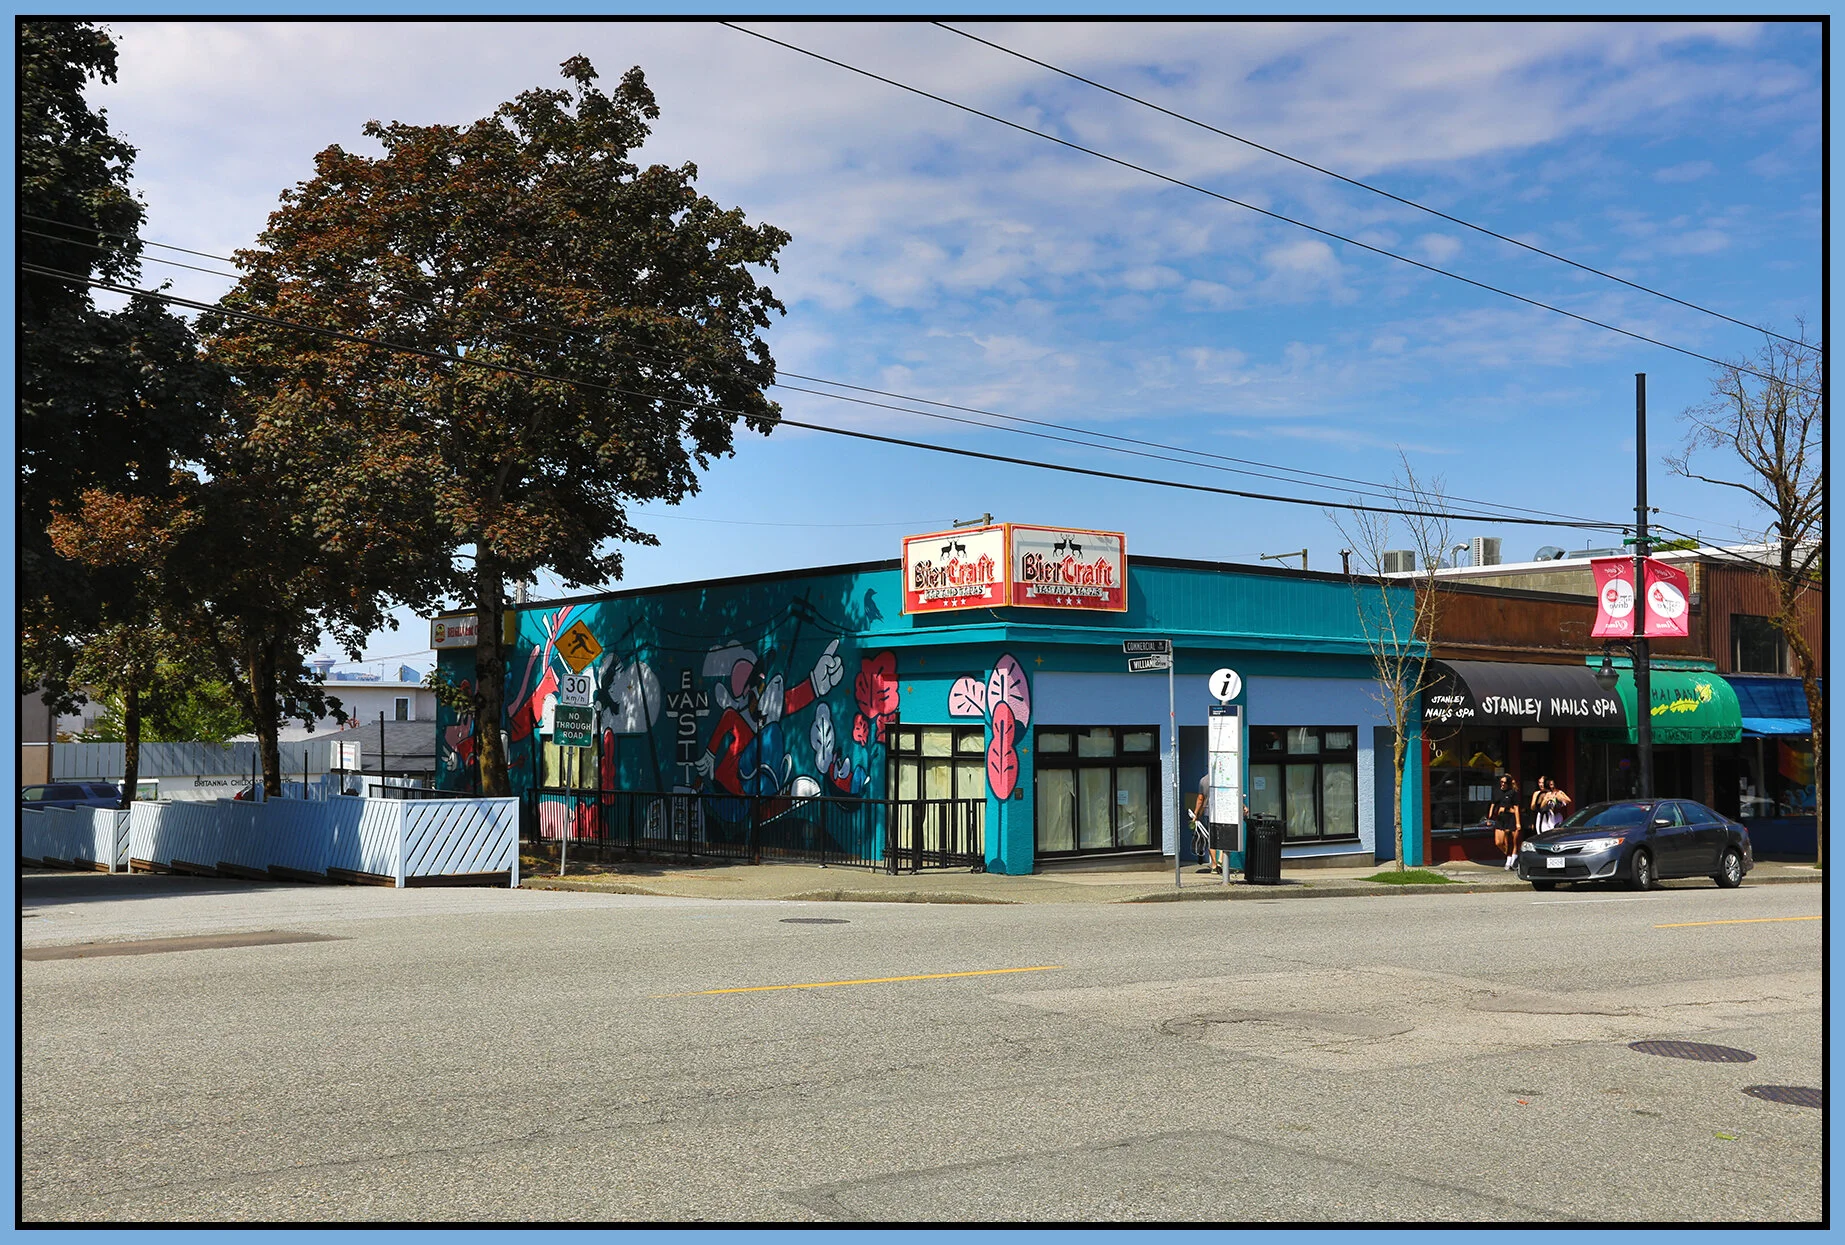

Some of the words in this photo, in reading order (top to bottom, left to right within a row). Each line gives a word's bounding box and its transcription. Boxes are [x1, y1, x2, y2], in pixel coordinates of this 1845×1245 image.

[1021, 552, 1115, 586] BierCraft
[566, 678, 587, 694] 30
[566, 694, 585, 702] km/h
[1431, 694, 1465, 706] STANLEY
[1651, 688, 1671, 701] HAI
[1425, 708, 1453, 718] NAILS
[1456, 707, 1475, 718] SPA
[1482, 696, 1542, 722] STANLEY
[1551, 697, 1589, 717] NAILS
[1592, 698, 1618, 718] SPA
[568, 712, 580, 721] NO
[556, 721, 592, 731] THROUGH
[563, 732, 584, 740] ROAD
[194, 779, 229, 787] BRITANNIA
